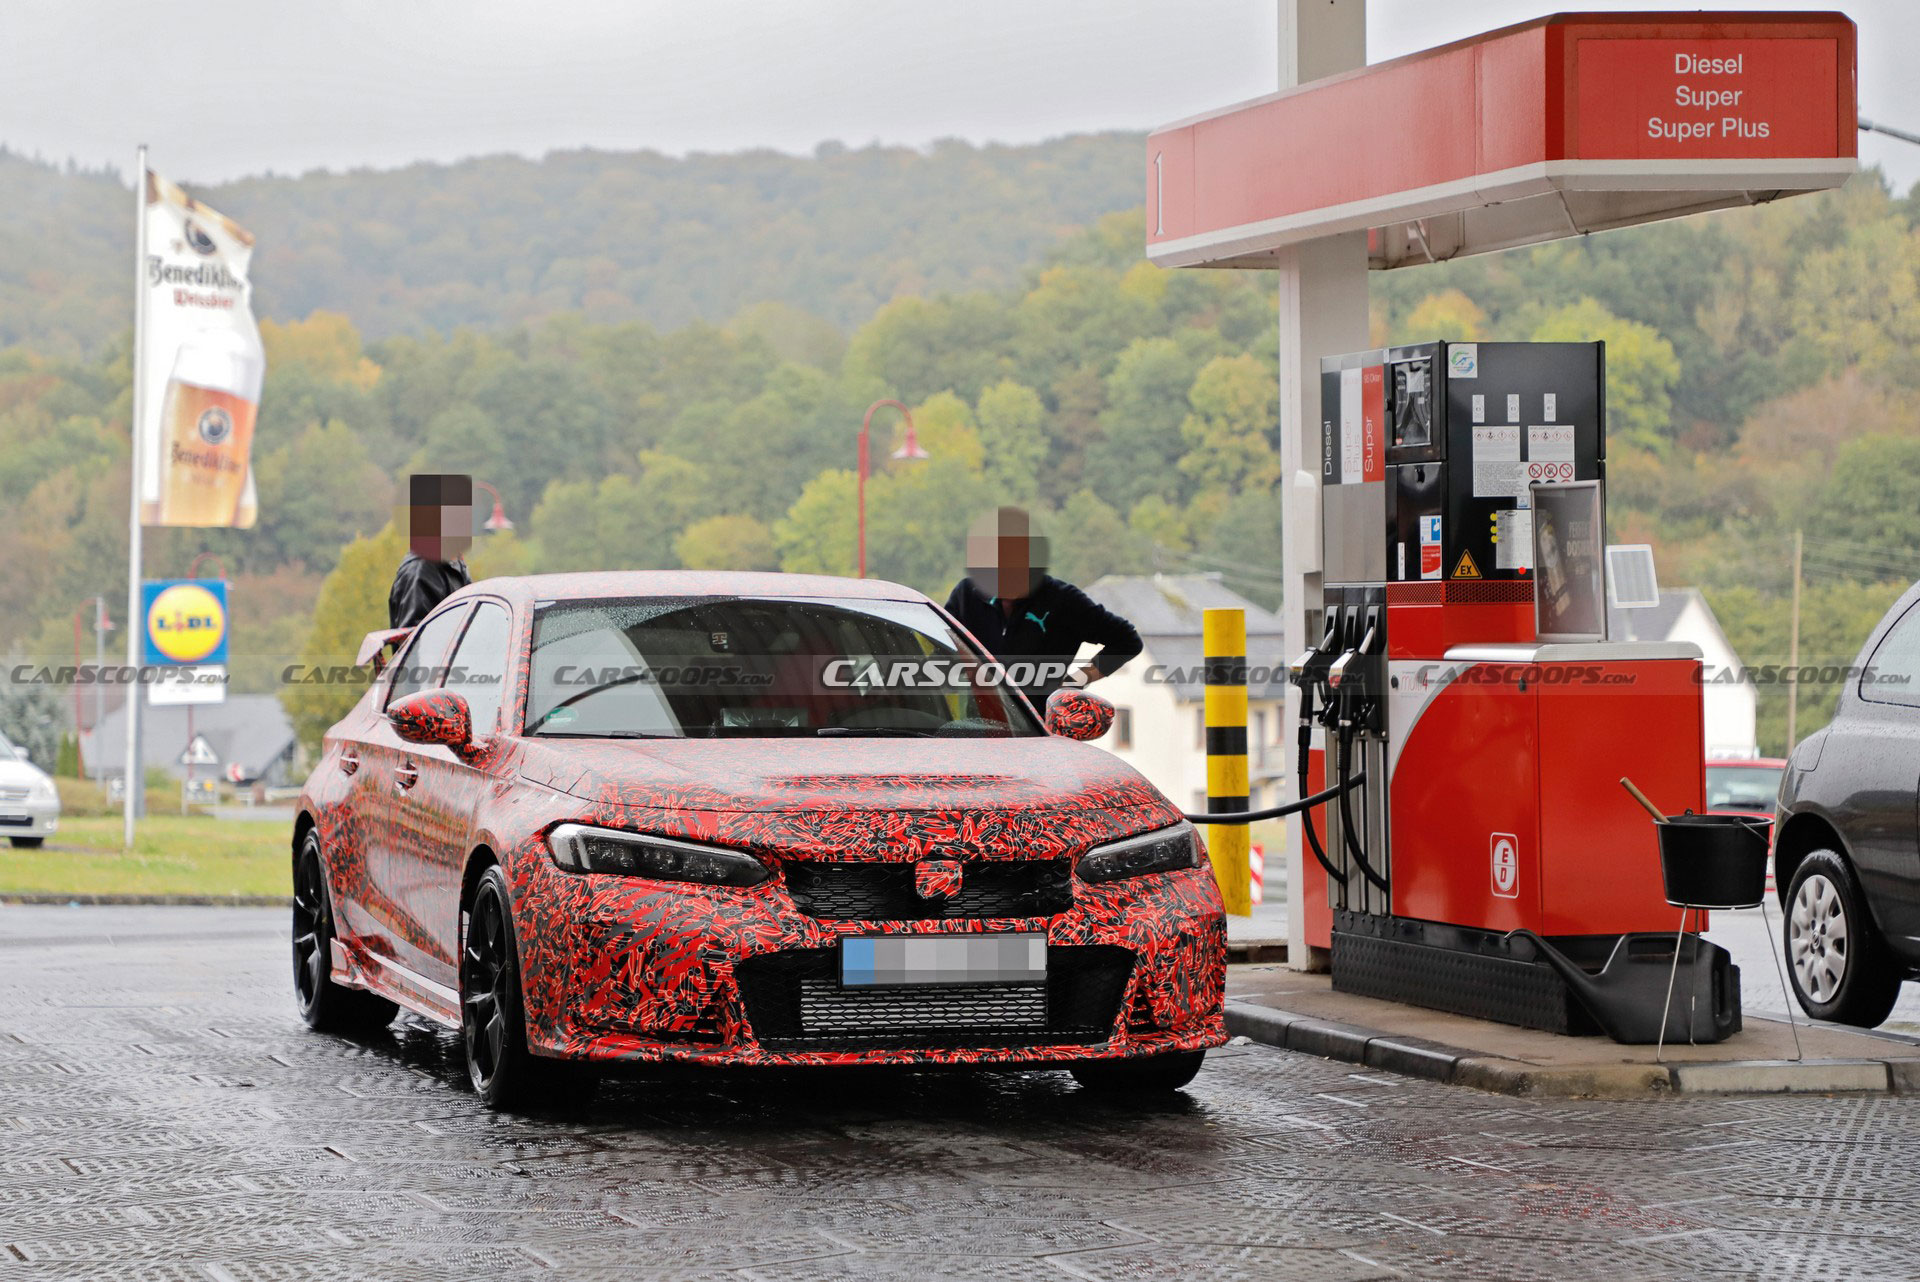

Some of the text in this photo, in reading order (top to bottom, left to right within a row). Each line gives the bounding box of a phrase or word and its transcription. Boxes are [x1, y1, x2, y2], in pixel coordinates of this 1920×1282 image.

[1675, 53, 1742, 74] Diesel
[1675, 85, 1743, 110] Super
[1647, 117, 1770, 142] Super Plus
[1324, 420, 1333, 476] Diesel
[1364, 416, 1375, 473] Super
[1460, 565, 1472, 575] EX
[1502, 847, 1509, 863] E
[1500, 867, 1507, 883] D
